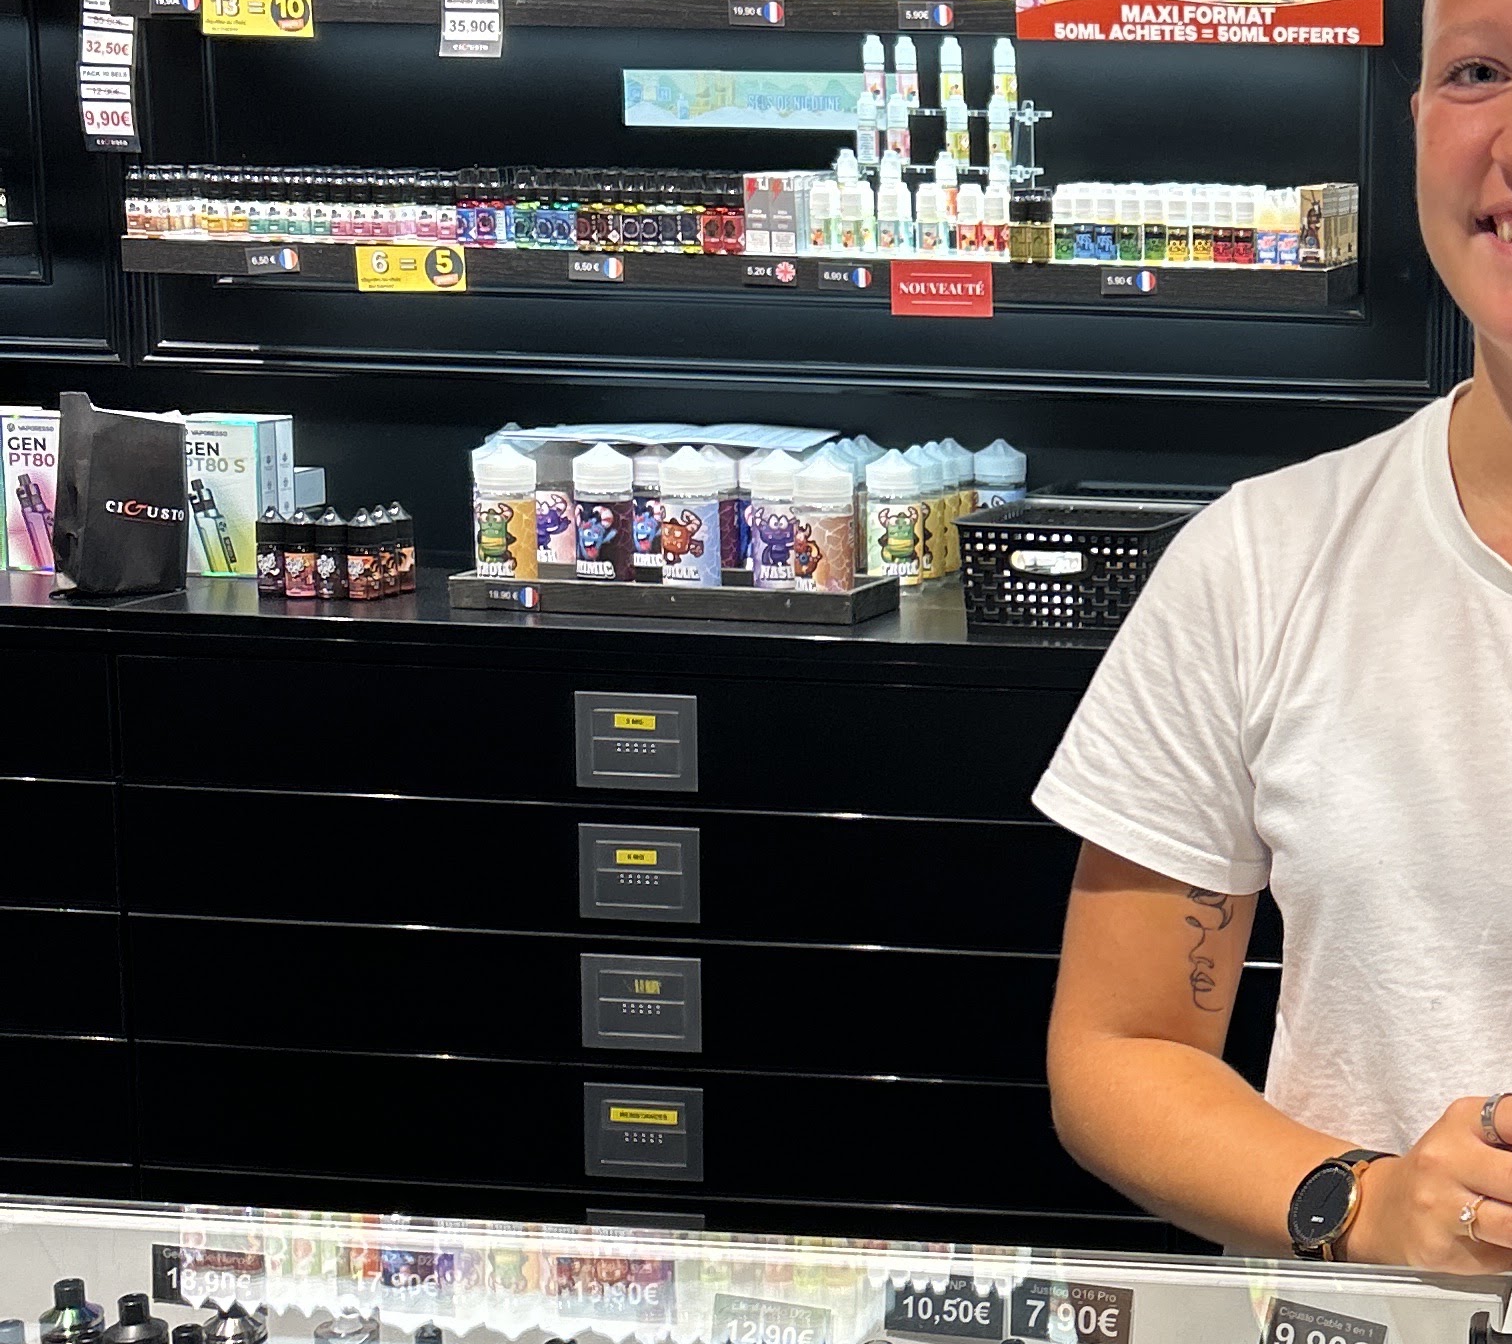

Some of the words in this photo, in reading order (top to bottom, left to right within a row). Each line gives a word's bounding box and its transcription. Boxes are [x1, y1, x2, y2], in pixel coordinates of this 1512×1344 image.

[1121, 4, 1180, 24] MAXI
[1183, 5, 1276, 26] FORMAT
[448, 19, 496, 34] 35,90€
[1054, 24, 1106, 40] 50ML
[1109, 21, 1198, 41] ACHETÉS
[1217, 25, 1270, 43] 50ML
[1273, 26, 1361, 44] OFFERTS
[86, 39, 130, 58] 32,50€
[85, 110, 132, 130] 9,90€
[371, 250, 389, 275] 6
[434, 250, 453, 275] 5
[899, 280, 985, 297] NOUVEAUTÉ
[7, 435, 48, 453] GEN
[9, 453, 56, 469] PT80
[233, 459, 246, 474] S
[105, 499, 186, 523] CIGUSTO
[1071, 1286, 1096, 1302] Q16
[1096, 1289, 1118, 1304] Pro
[902, 1294, 992, 1326] 10,50€
[1025, 1298, 1120, 1338] 7,90€
[1279, 1306, 1315, 1324] Cigusto
[1315, 1315, 1344, 1331] Cable
[1344, 1322, 1353, 1333] 3
[1352, 1325, 1366, 1336] en
